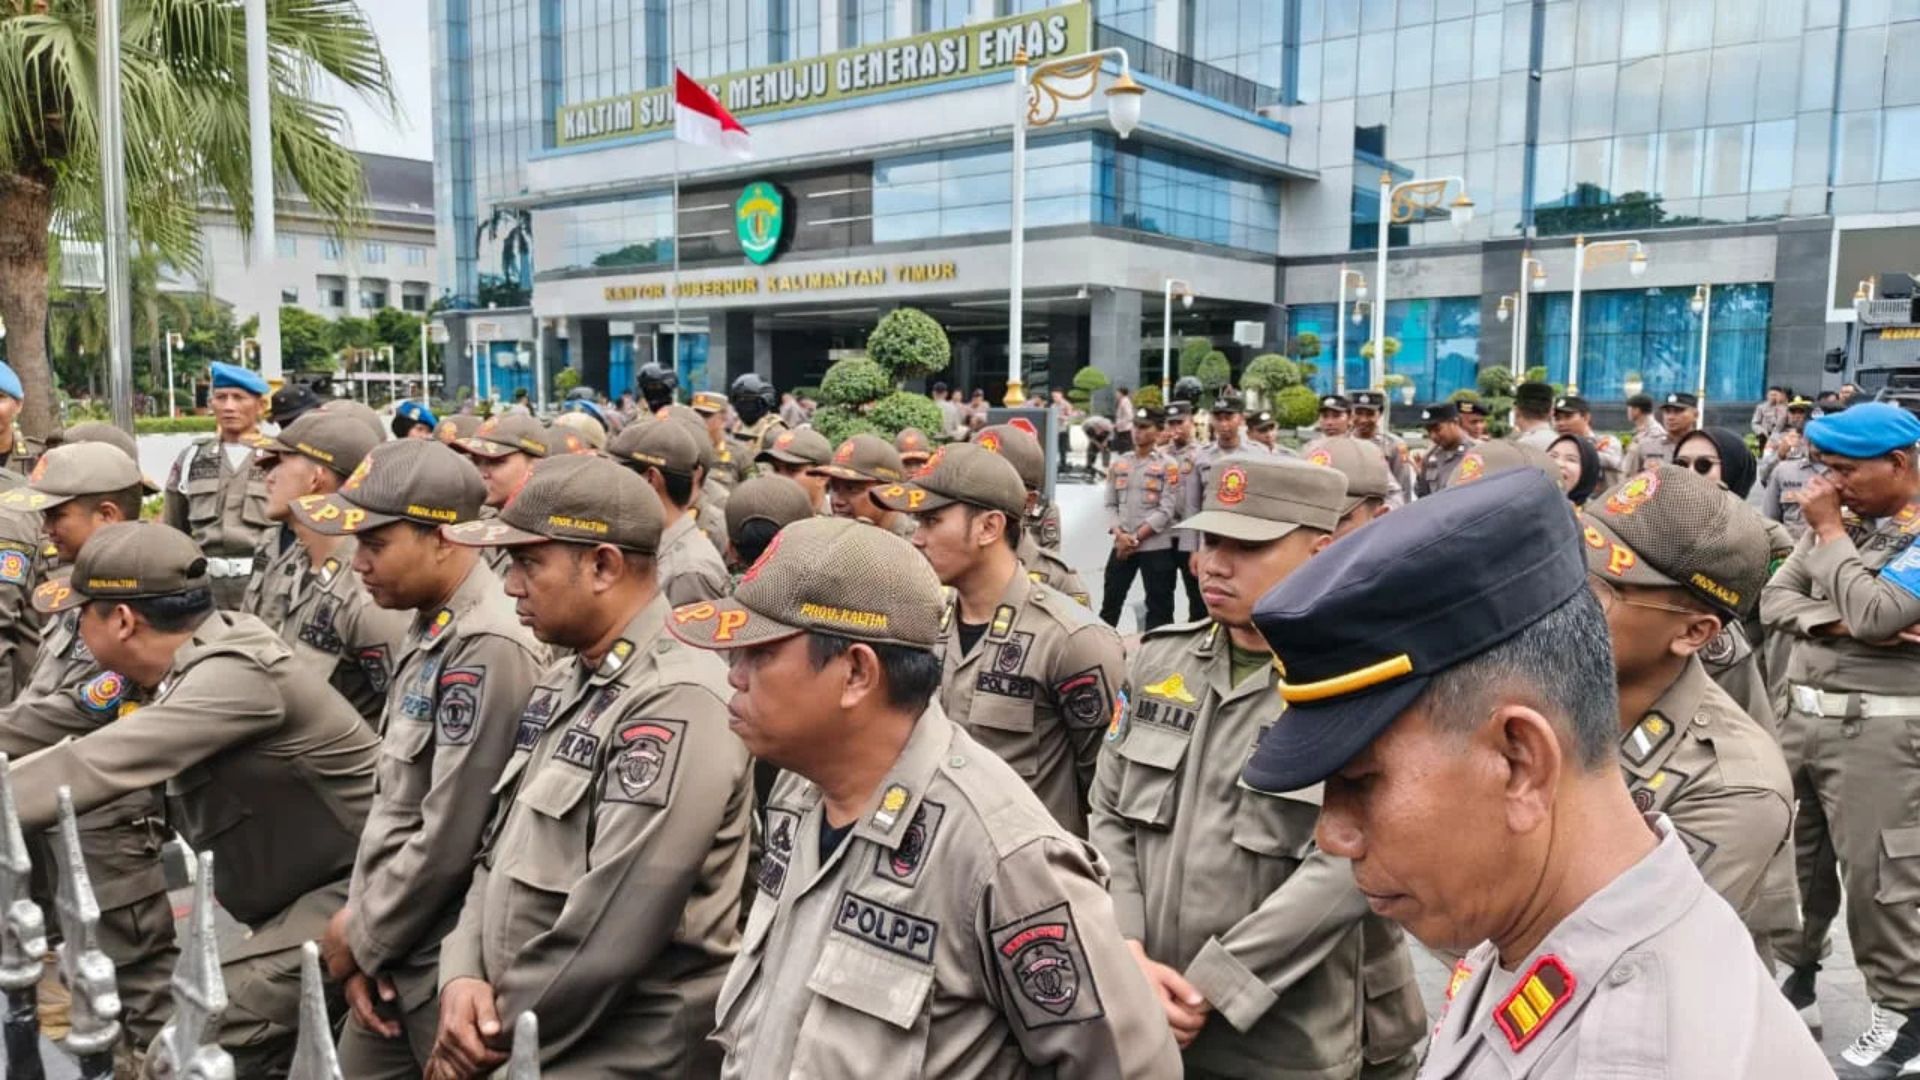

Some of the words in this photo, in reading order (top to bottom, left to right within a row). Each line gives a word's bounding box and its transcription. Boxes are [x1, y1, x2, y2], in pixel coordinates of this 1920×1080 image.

[564, 100, 633, 142] KALTIM
[640, 83, 722, 126] SUS
[729, 64, 828, 111] MENUJU
[836, 34, 969, 93] GENERASI
[979, 15, 1067, 68] EMAS
[604, 284, 665, 301] KANTOR
[767, 266, 886, 293] KALIMANTAN
[893, 262, 956, 284] TIMUR
[839, 899, 930, 950] POLPP
